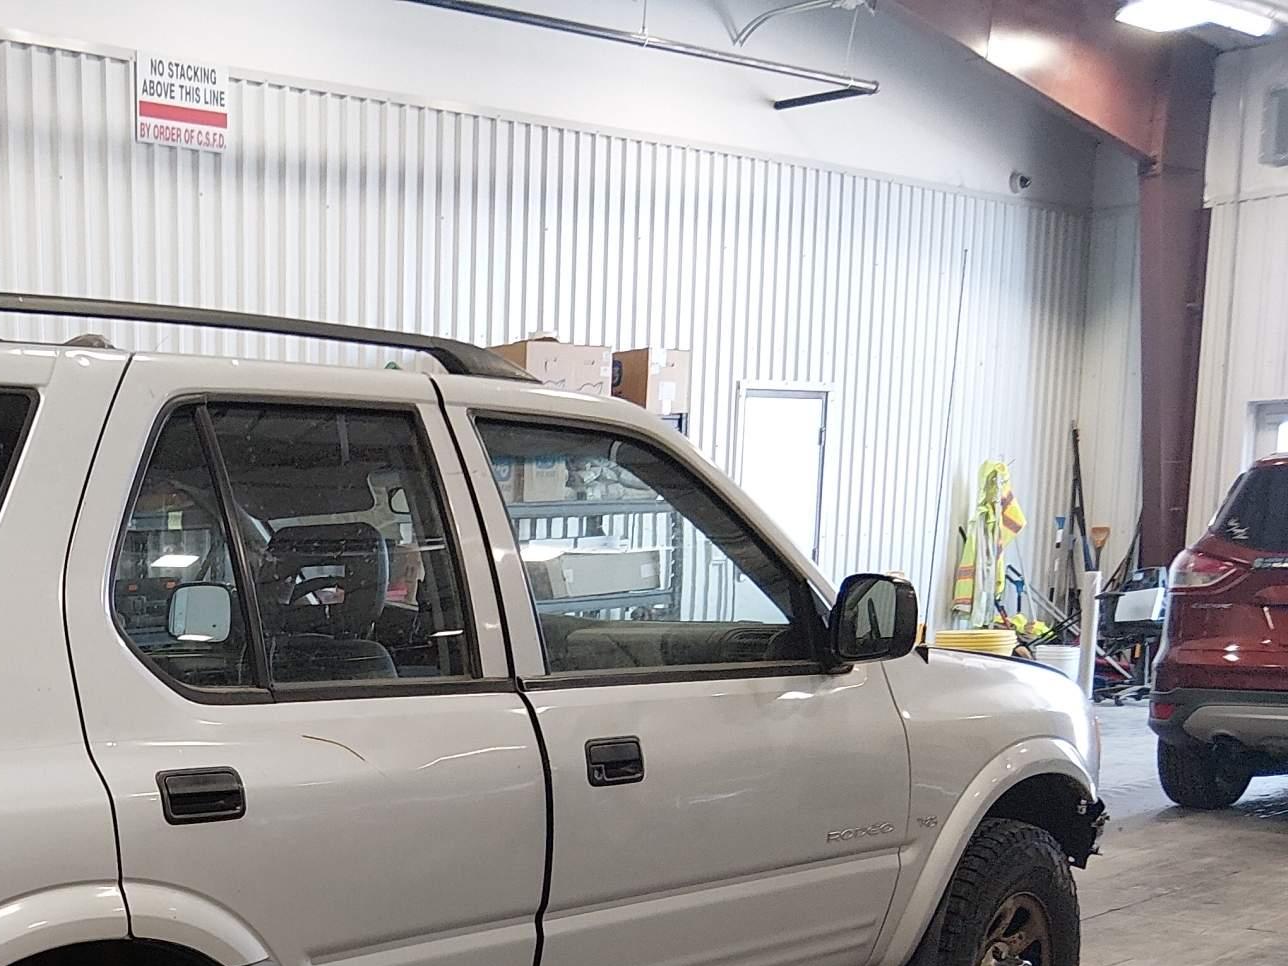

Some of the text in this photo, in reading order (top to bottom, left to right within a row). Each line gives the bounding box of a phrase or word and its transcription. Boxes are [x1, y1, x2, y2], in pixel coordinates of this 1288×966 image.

[150, 58, 217, 85] NO STACKING
[142, 79, 225, 107] ABOVE THIS LINE
[140, 122, 227, 149] BY ORDER OF C.S.F.D.
[826, 822, 895, 844] RODEO
